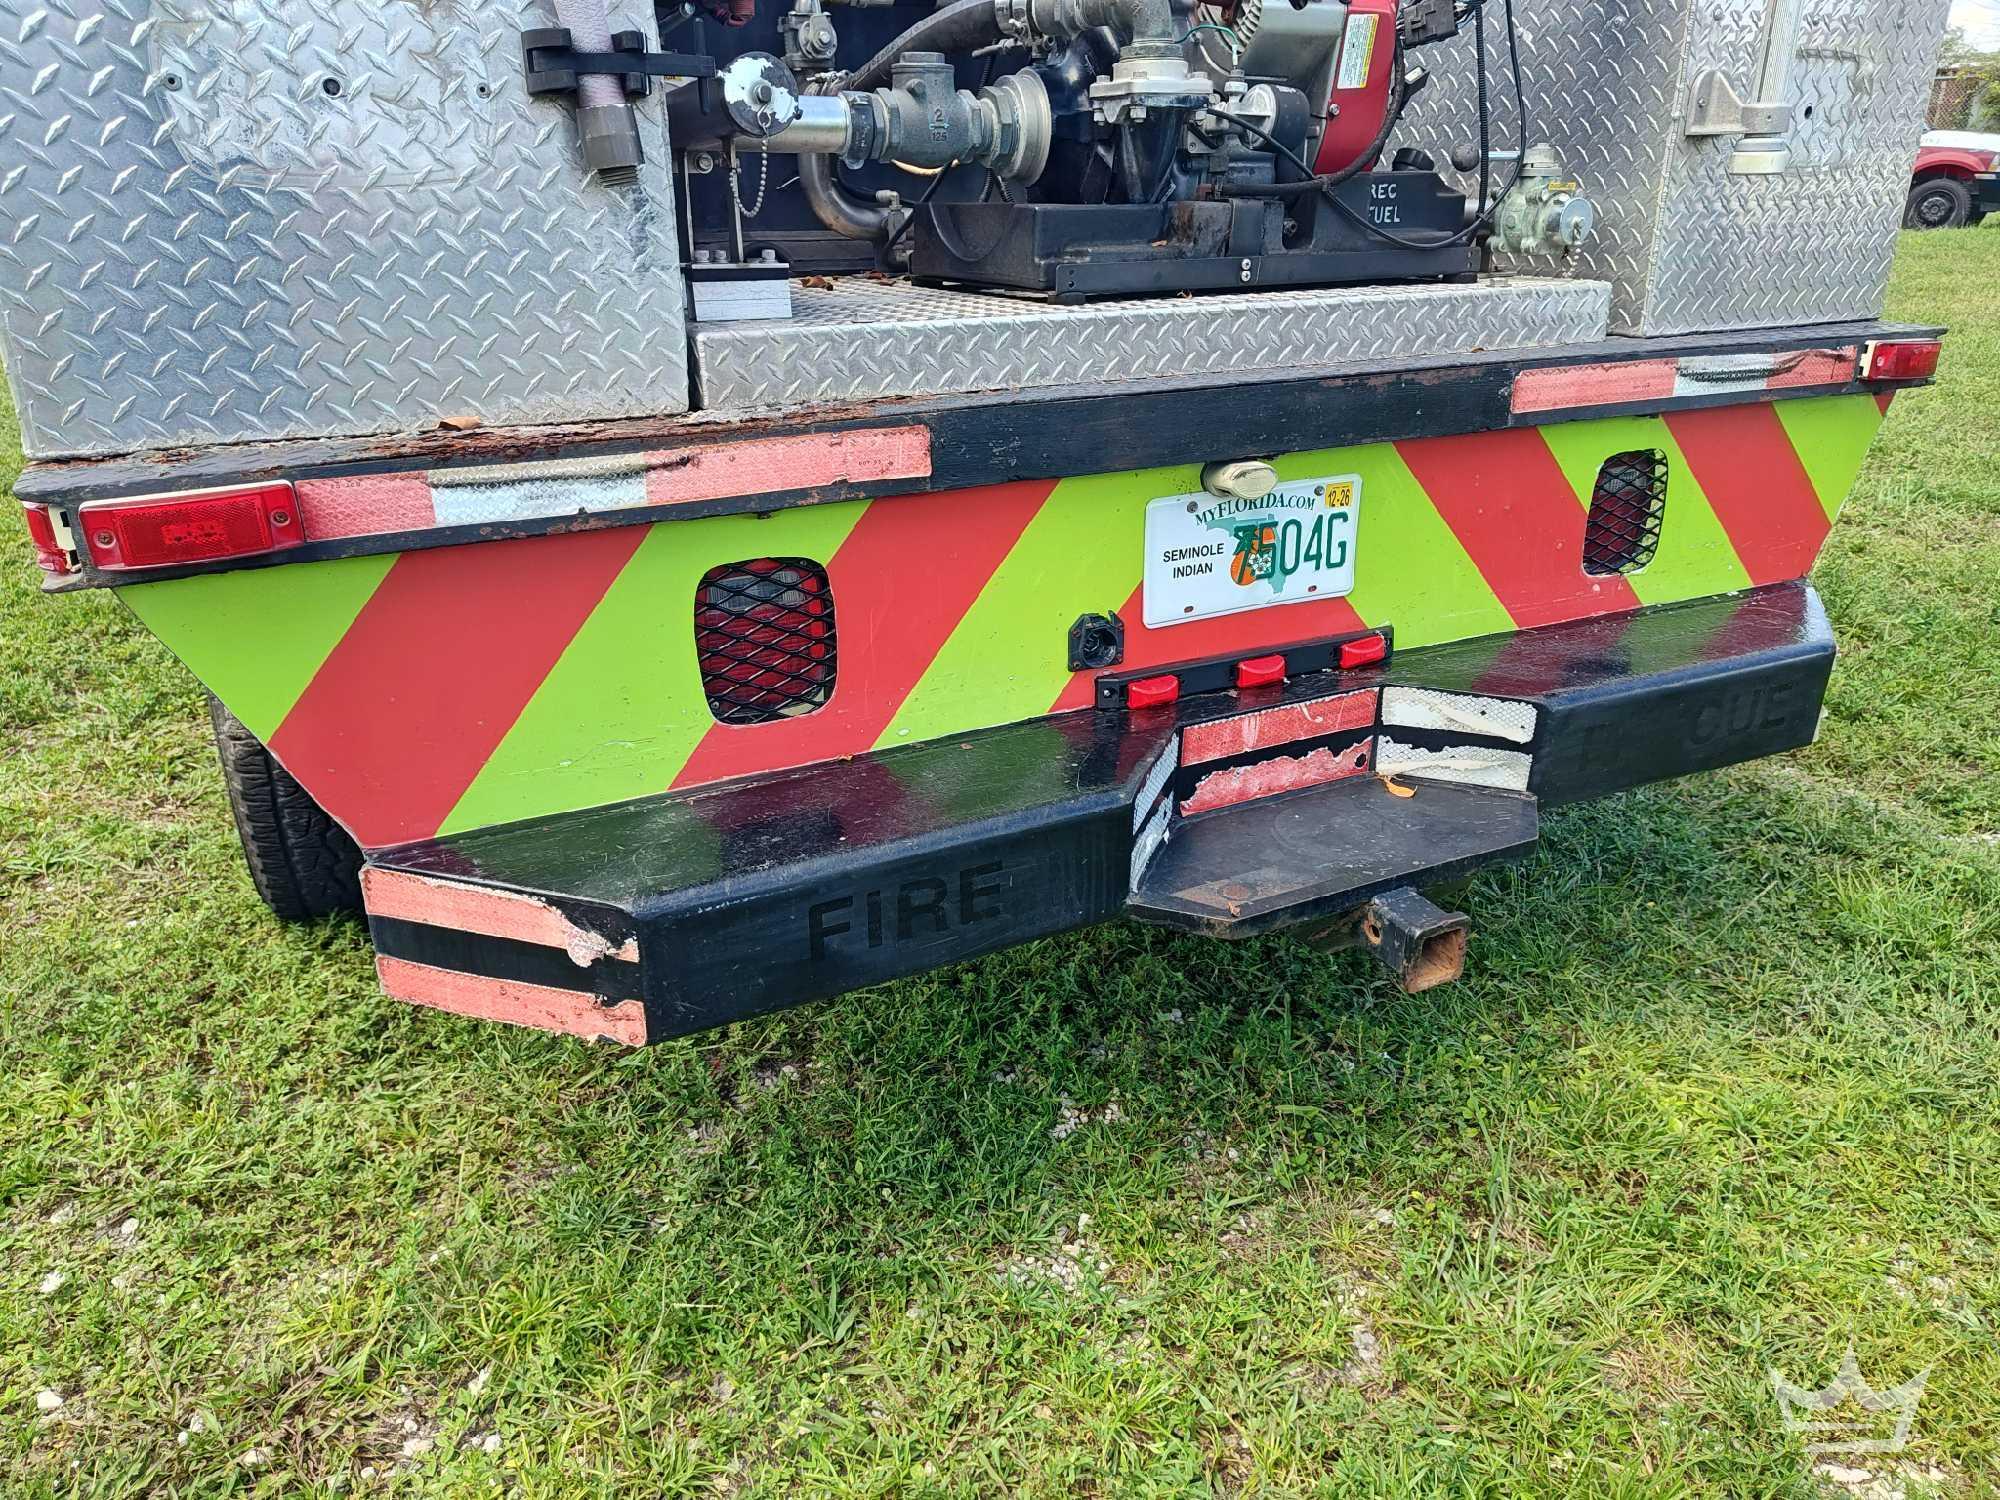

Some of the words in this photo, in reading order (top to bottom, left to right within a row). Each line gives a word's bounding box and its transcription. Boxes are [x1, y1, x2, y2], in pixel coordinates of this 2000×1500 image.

[1163, 543, 1225, 563] SEMINOLE
[1173, 563, 1213, 579] INDIAN
[808, 861, 1003, 961] FIRE
